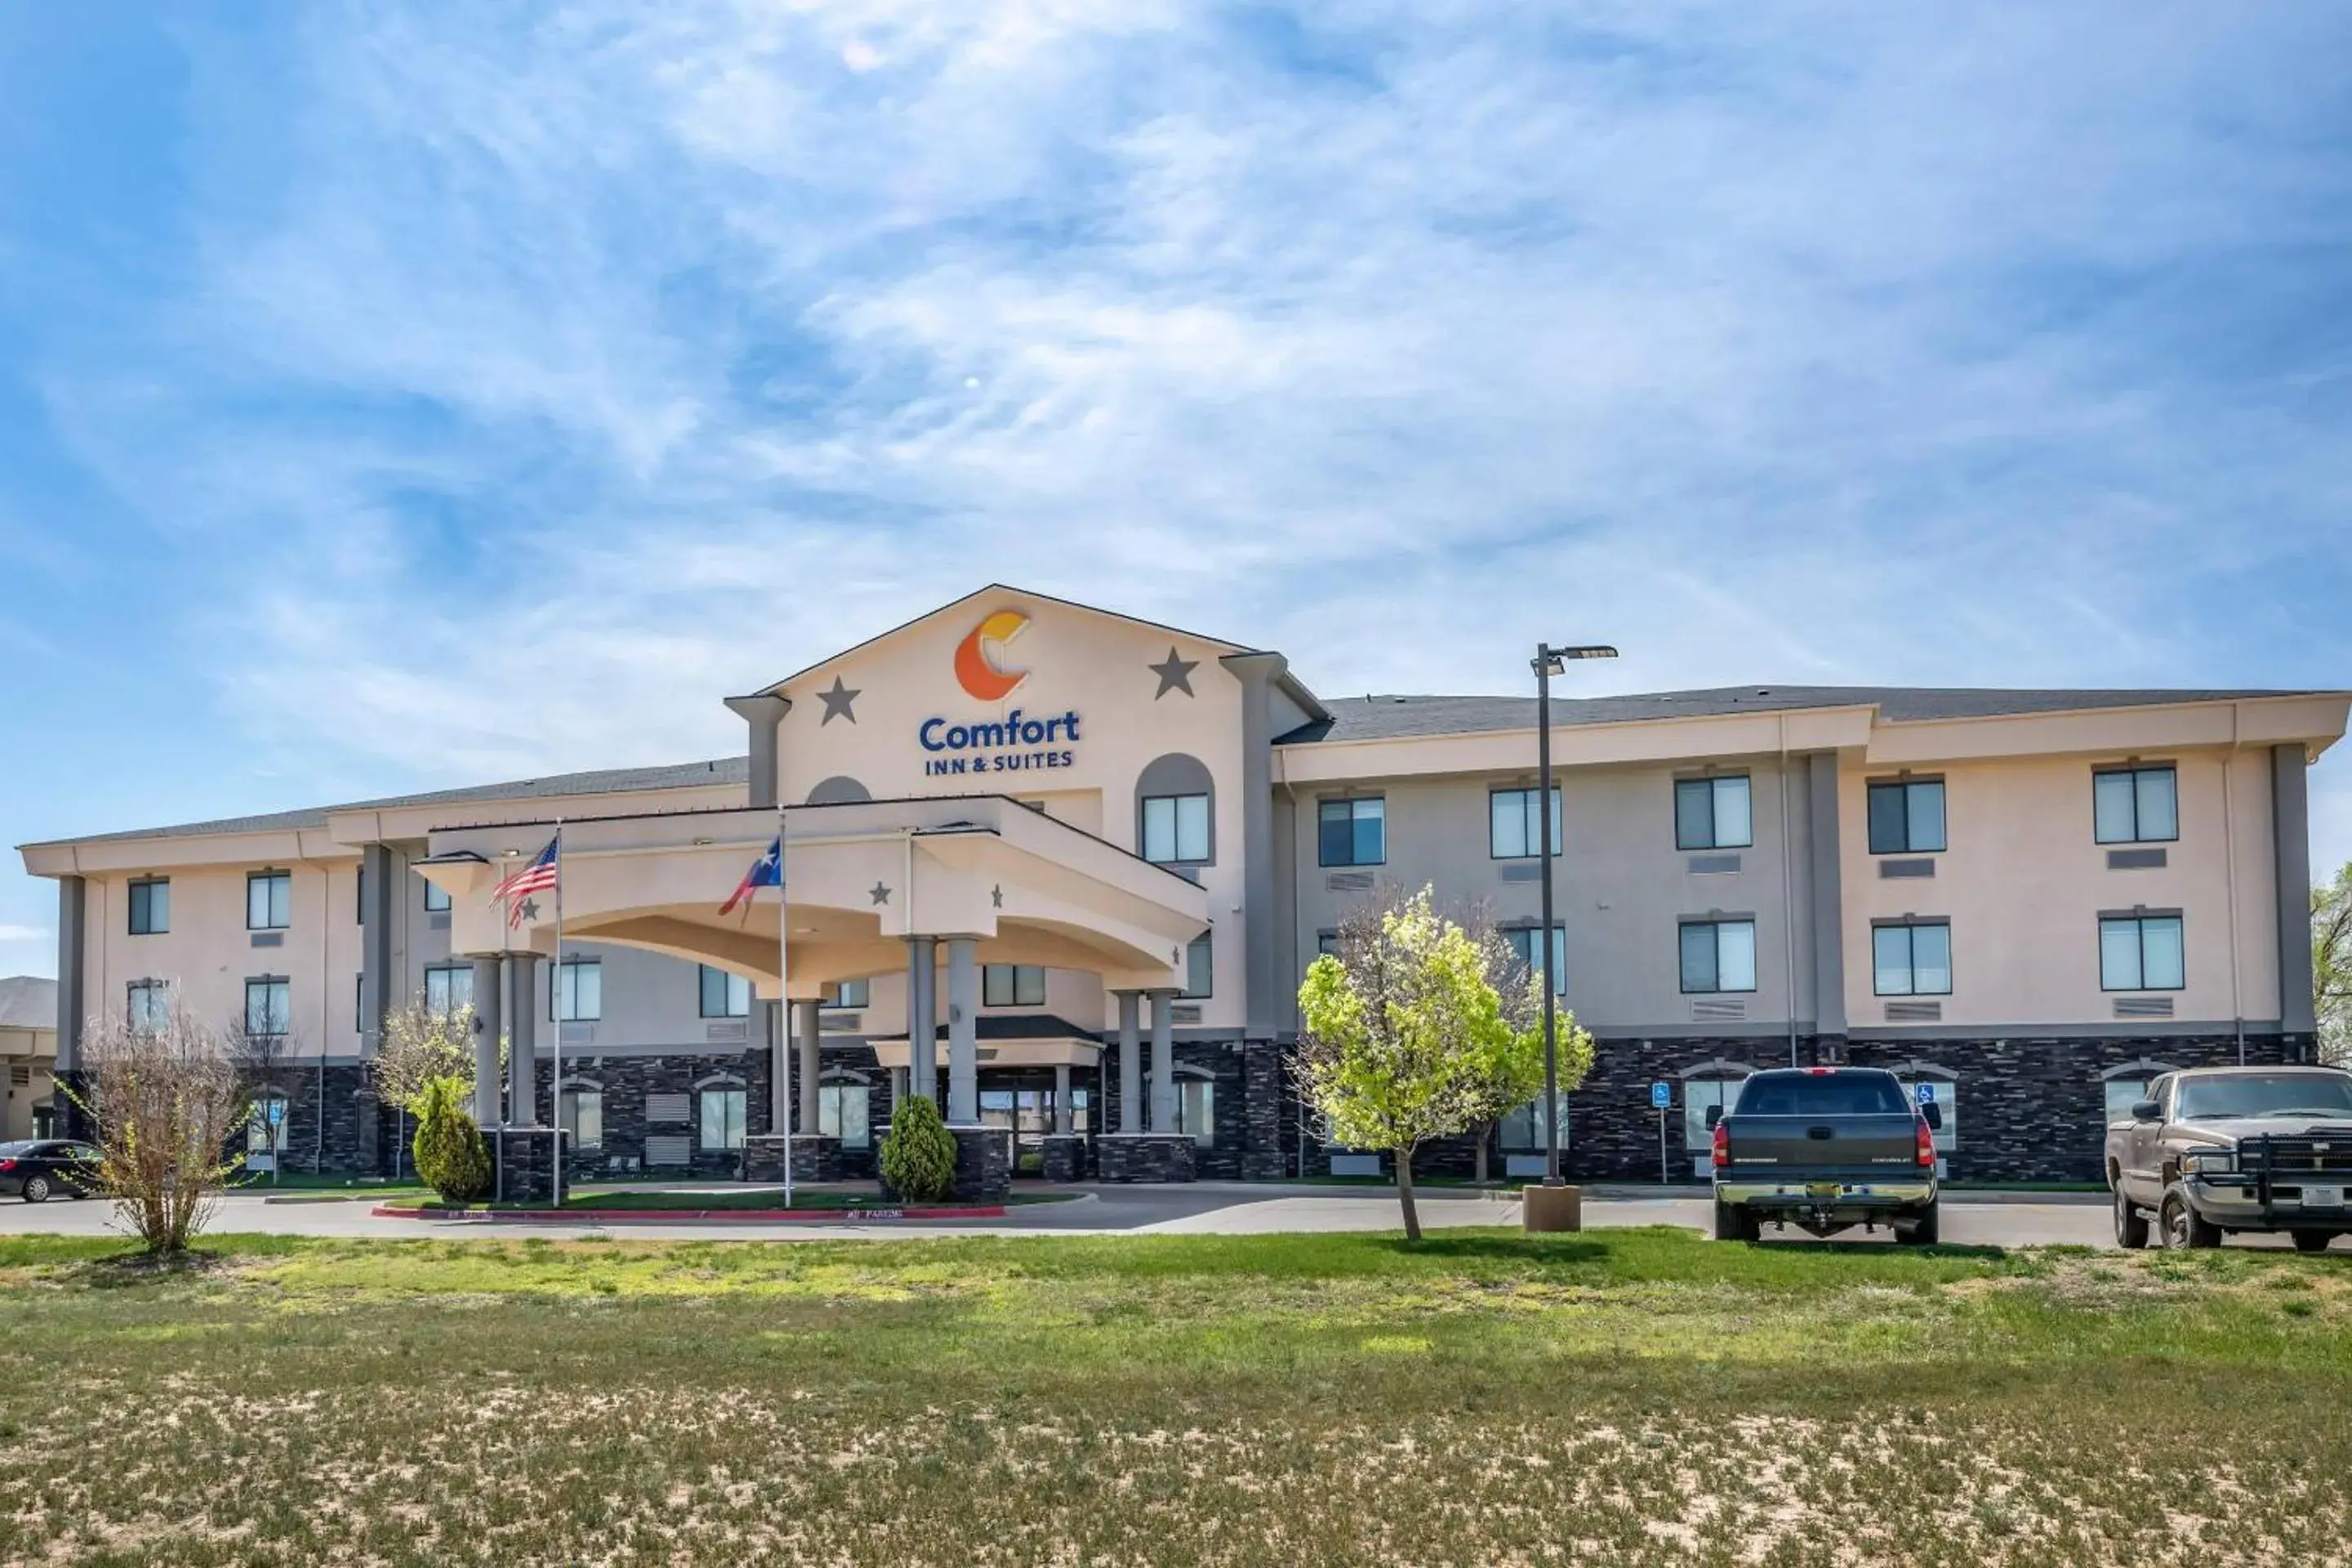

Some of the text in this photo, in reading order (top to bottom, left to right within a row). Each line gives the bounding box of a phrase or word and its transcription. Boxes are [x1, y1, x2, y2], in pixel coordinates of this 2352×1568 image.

[920, 710, 1080, 751] Comfort
[925, 751, 1072, 776] INN & SUITES
